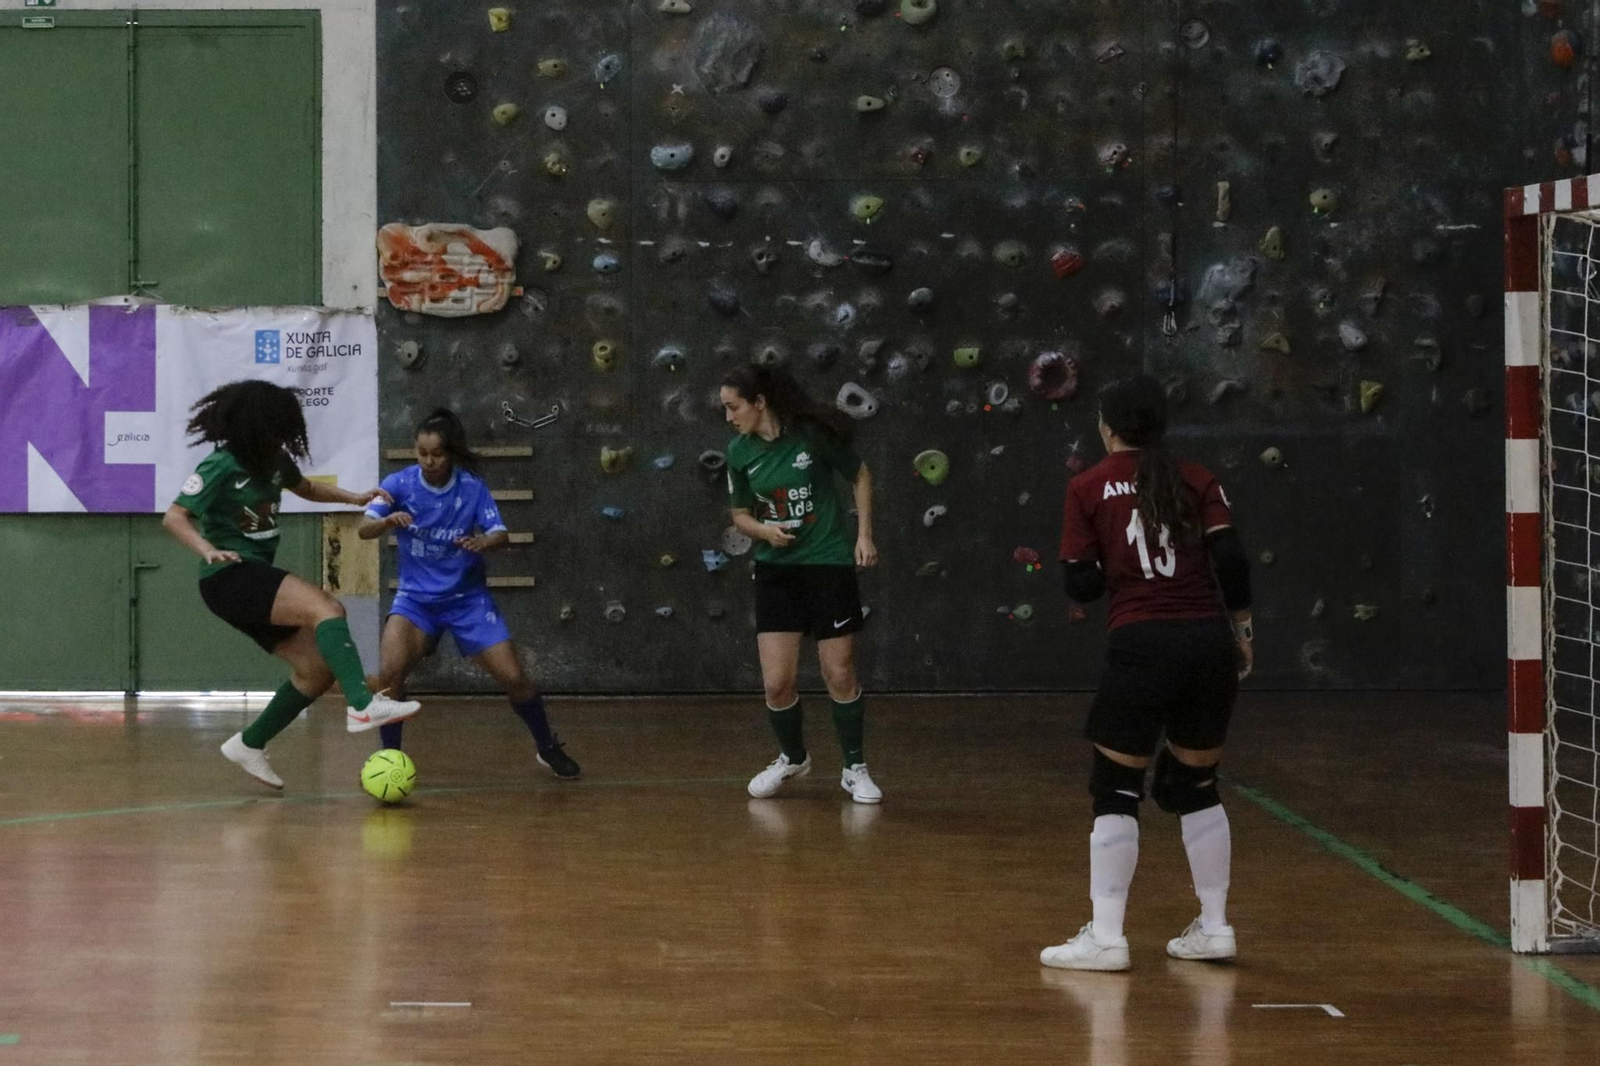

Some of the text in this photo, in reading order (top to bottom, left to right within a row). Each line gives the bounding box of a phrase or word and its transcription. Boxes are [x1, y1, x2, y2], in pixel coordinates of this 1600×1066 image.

[286, 331, 331, 344] XUNTA
[286, 344, 362, 358] DE GALICIA
[299, 387, 334, 397] PORTE
[301, 398, 329, 407] LEGO
[107, 432, 150, 447] galicia
[1125, 508, 1176, 579] 13
